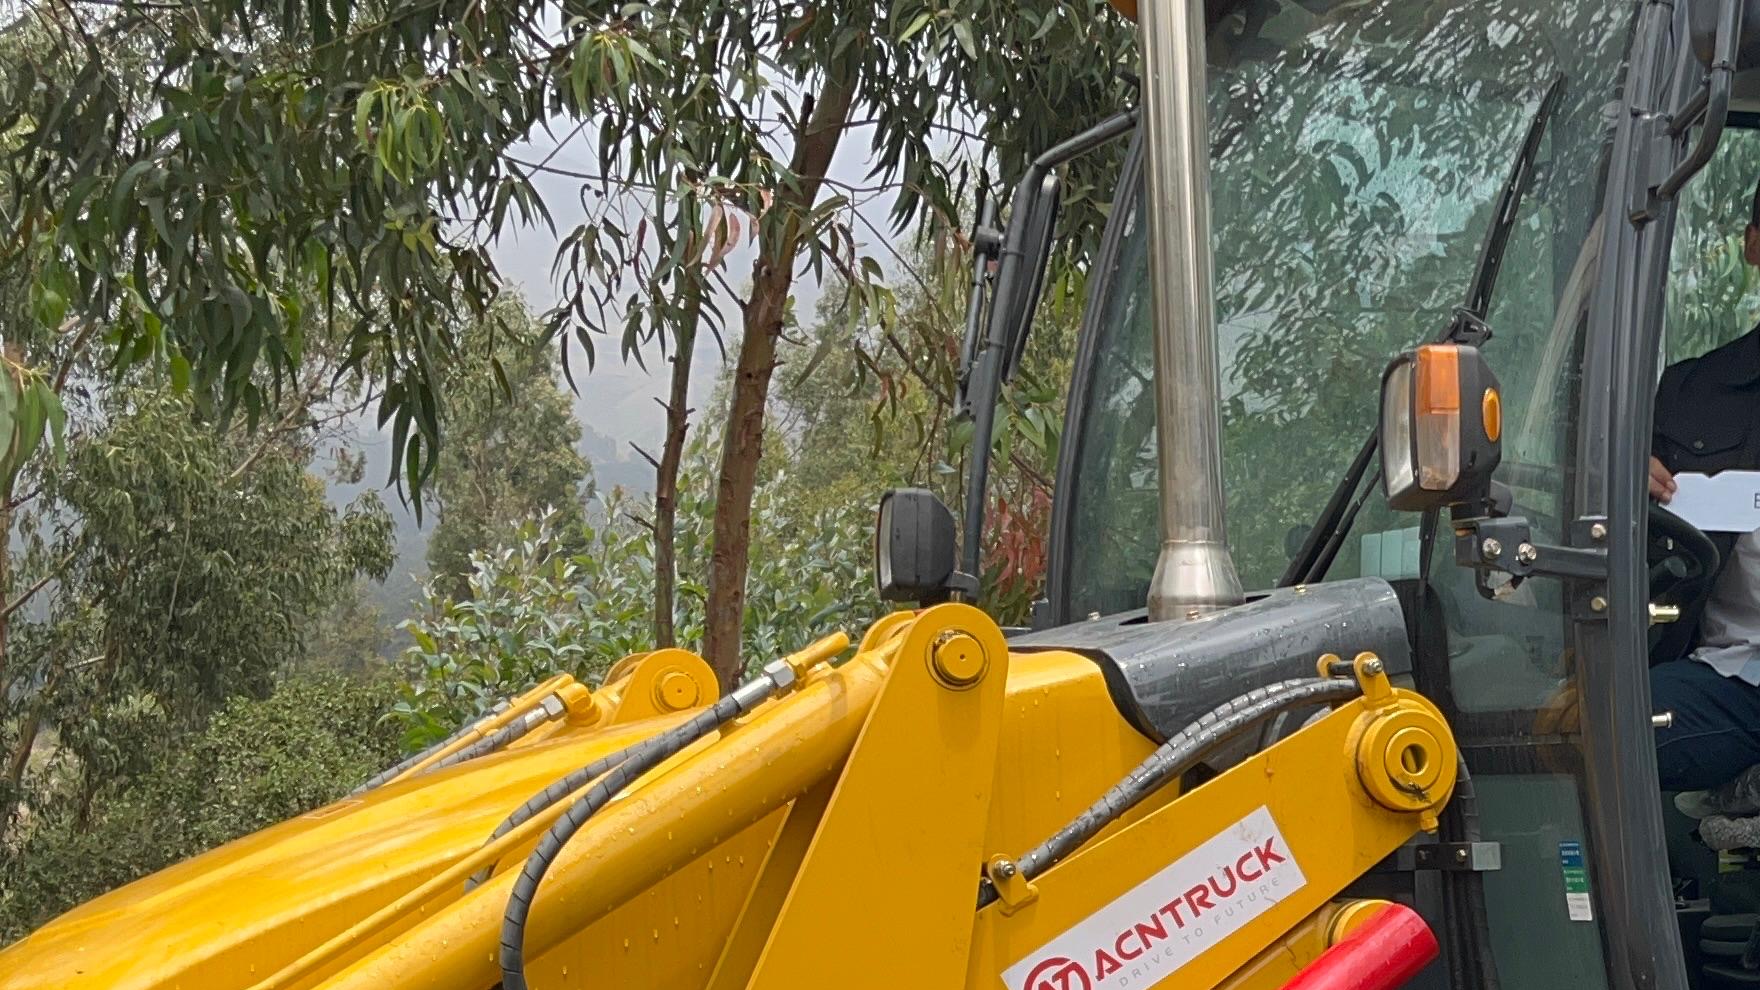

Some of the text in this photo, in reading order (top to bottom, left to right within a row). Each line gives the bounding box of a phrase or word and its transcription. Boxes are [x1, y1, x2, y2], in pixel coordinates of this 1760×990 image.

[1095, 836, 1287, 982] ACNTRUCK
[1119, 876, 1280, 988] DRIVE TO FUTURE
